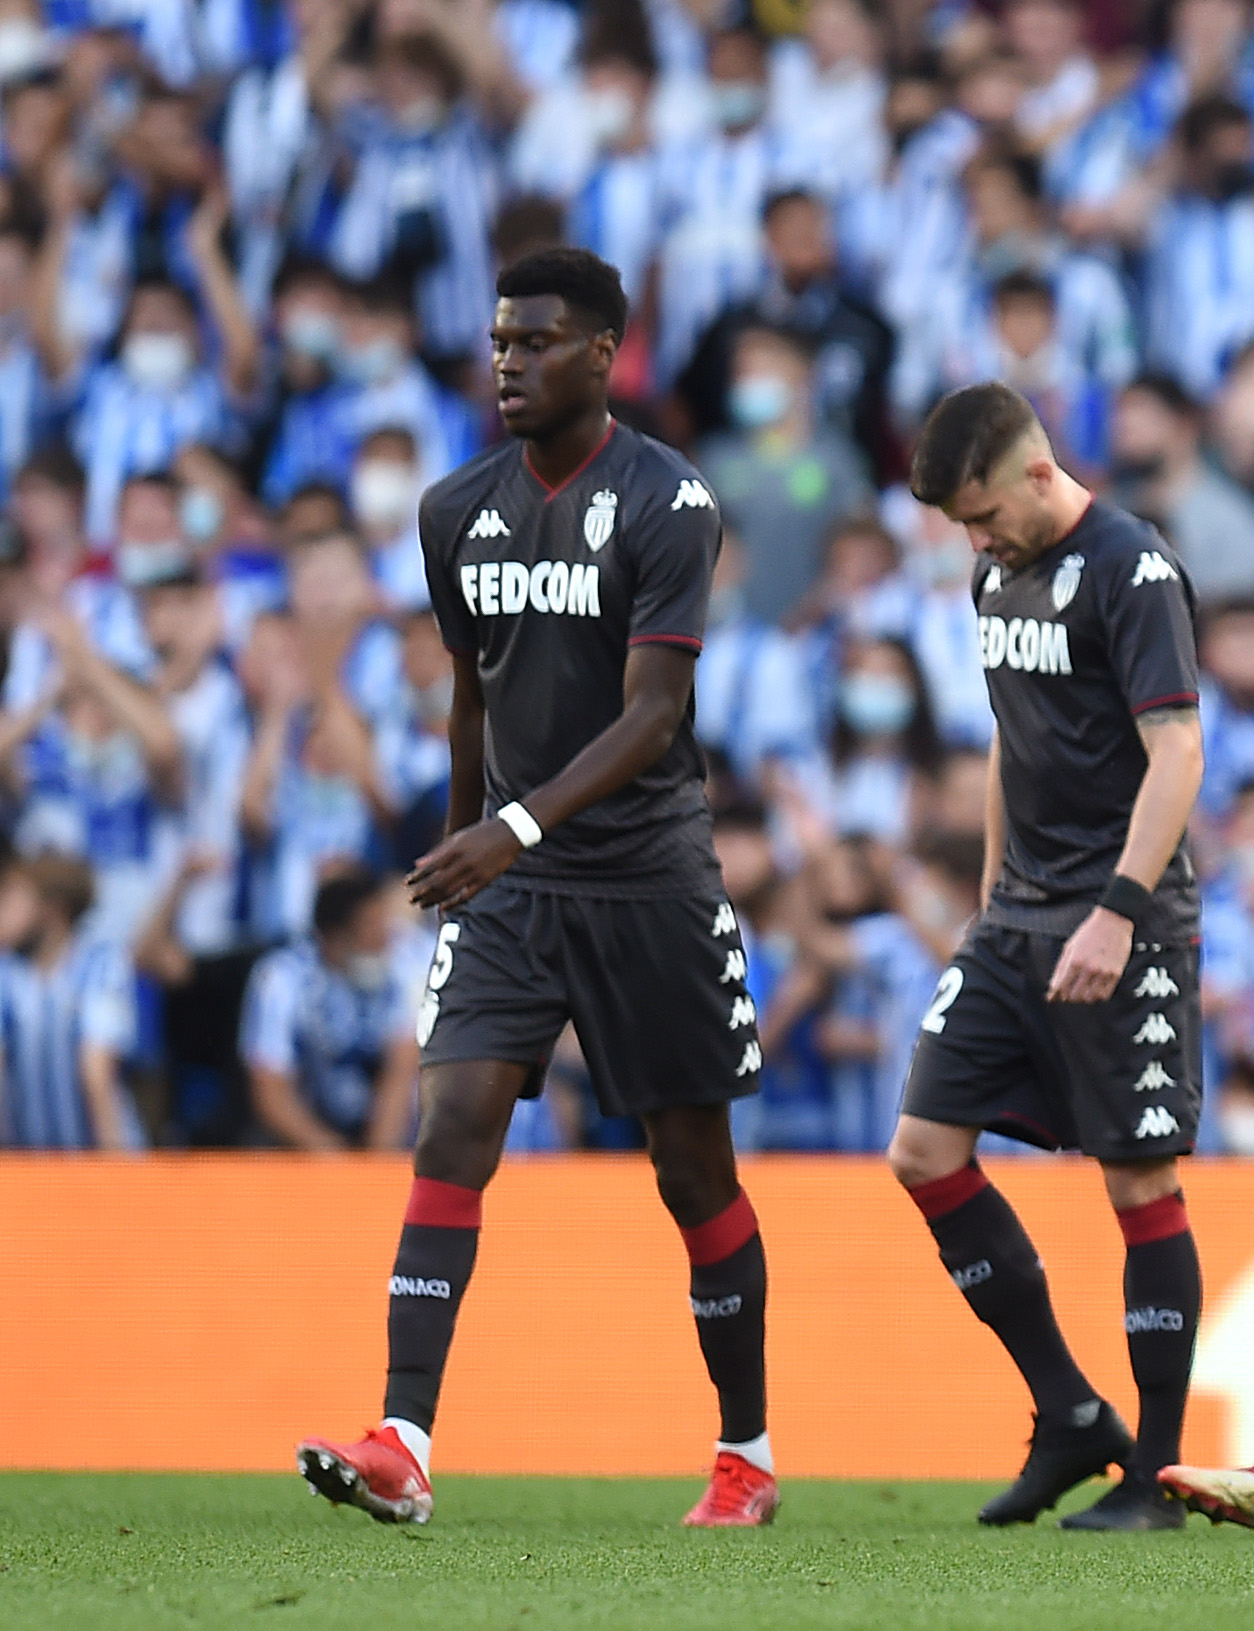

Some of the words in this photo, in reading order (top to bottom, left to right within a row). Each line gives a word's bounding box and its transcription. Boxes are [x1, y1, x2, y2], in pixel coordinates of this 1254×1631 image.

[460, 561, 601, 617] FEDCOM
[430, 922, 461, 990] 5
[921, 966, 964, 1034] 2
[389, 1275, 451, 1299] ONACO
